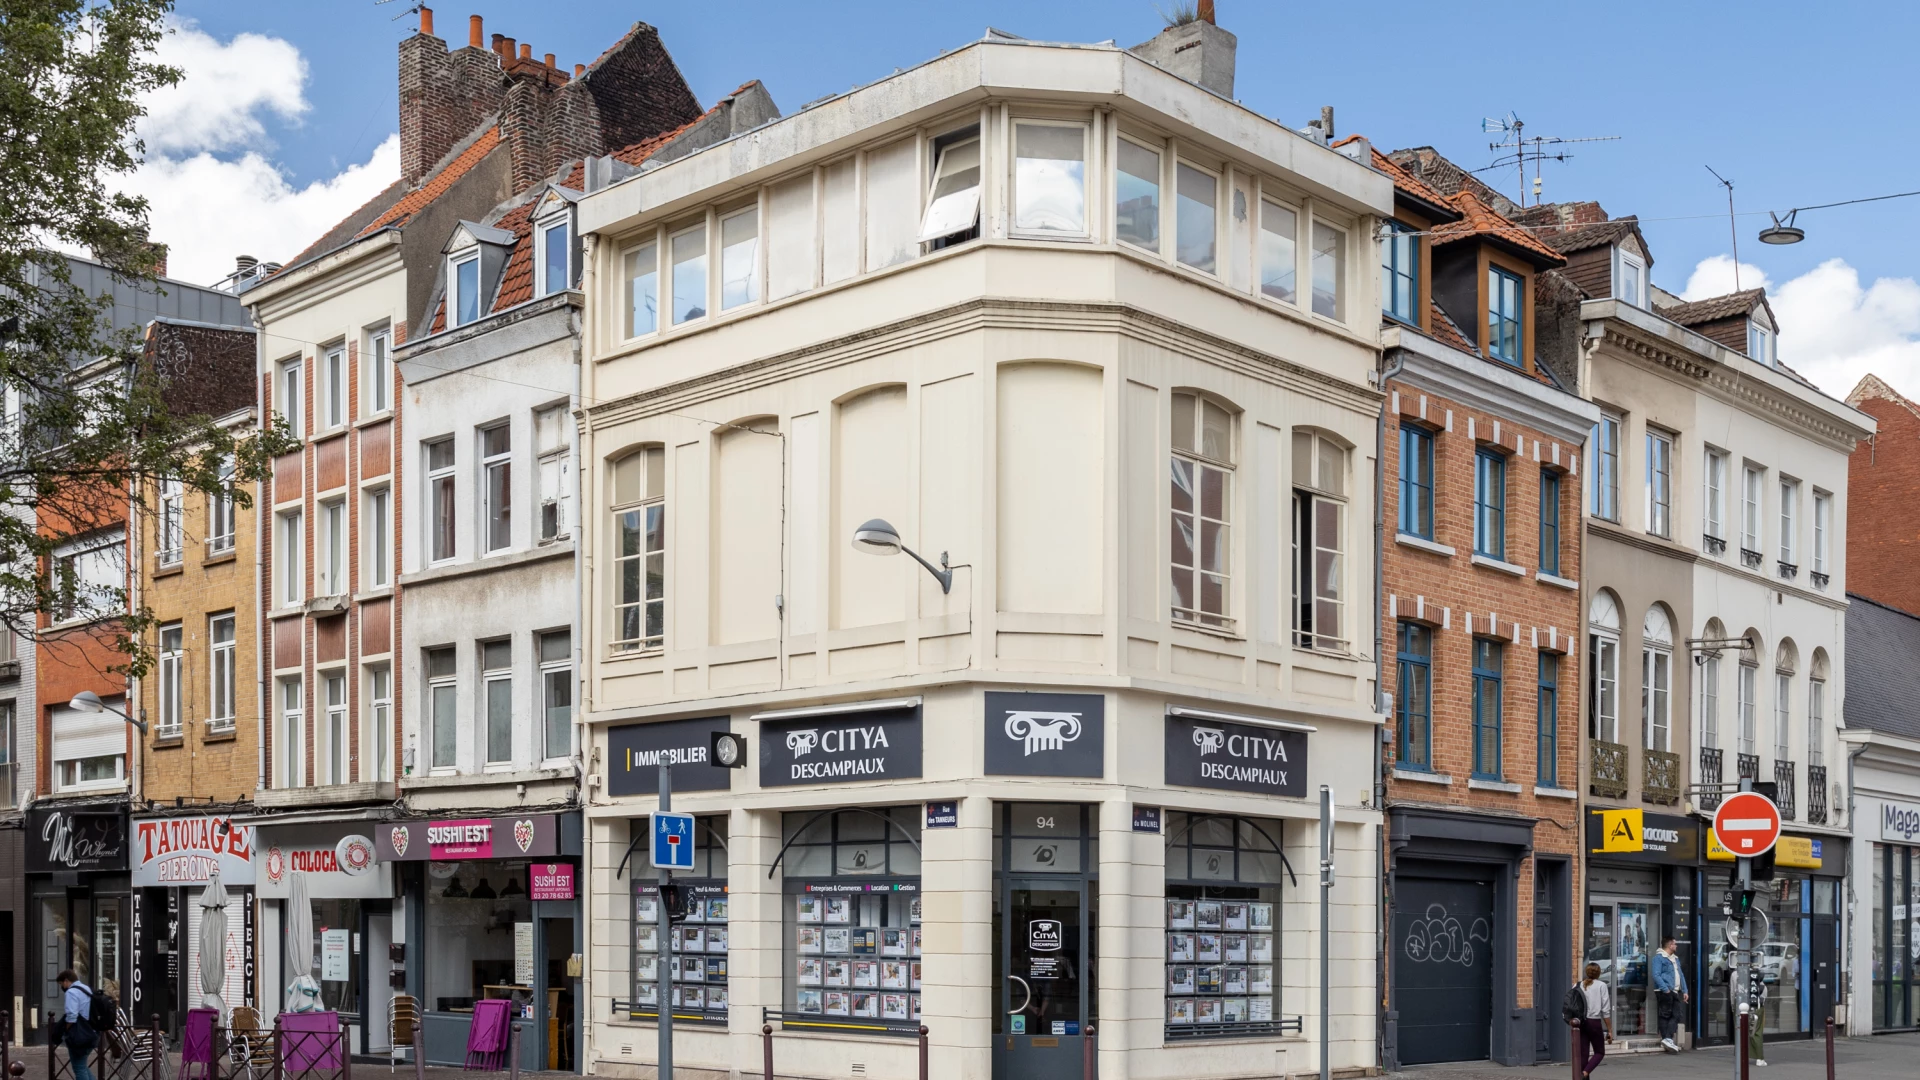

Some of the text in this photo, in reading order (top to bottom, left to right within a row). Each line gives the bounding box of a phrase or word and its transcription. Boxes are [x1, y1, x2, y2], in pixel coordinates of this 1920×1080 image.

[821, 726, 889, 753] CITYA
[1227, 734, 1288, 762] CITYA
[791, 757, 885, 780] DESCAMPIAUX
[1201, 762, 1288, 786] DESCAMPIAUX
[935, 815, 956, 823] TANNEURS
[942, 805, 950, 813] Rue
[1146, 810, 1155, 818] Rue
[1036, 816, 1055, 829] 94
[1140, 820, 1159, 828] MOLINEL
[1885, 804, 1920, 840] Maga
[138, 817, 250, 865] TATOUAGE
[427, 824, 492, 844] SUSHI EST
[157, 854, 221, 882] PIERCING
[291, 850, 344, 873] COLOCA
[534, 875, 570, 887] SUSHI EST
[1032, 931, 1058, 939] CITYA
[133, 894, 142, 1002] TATTOO
[245, 893, 254, 1007] PIERCIN
